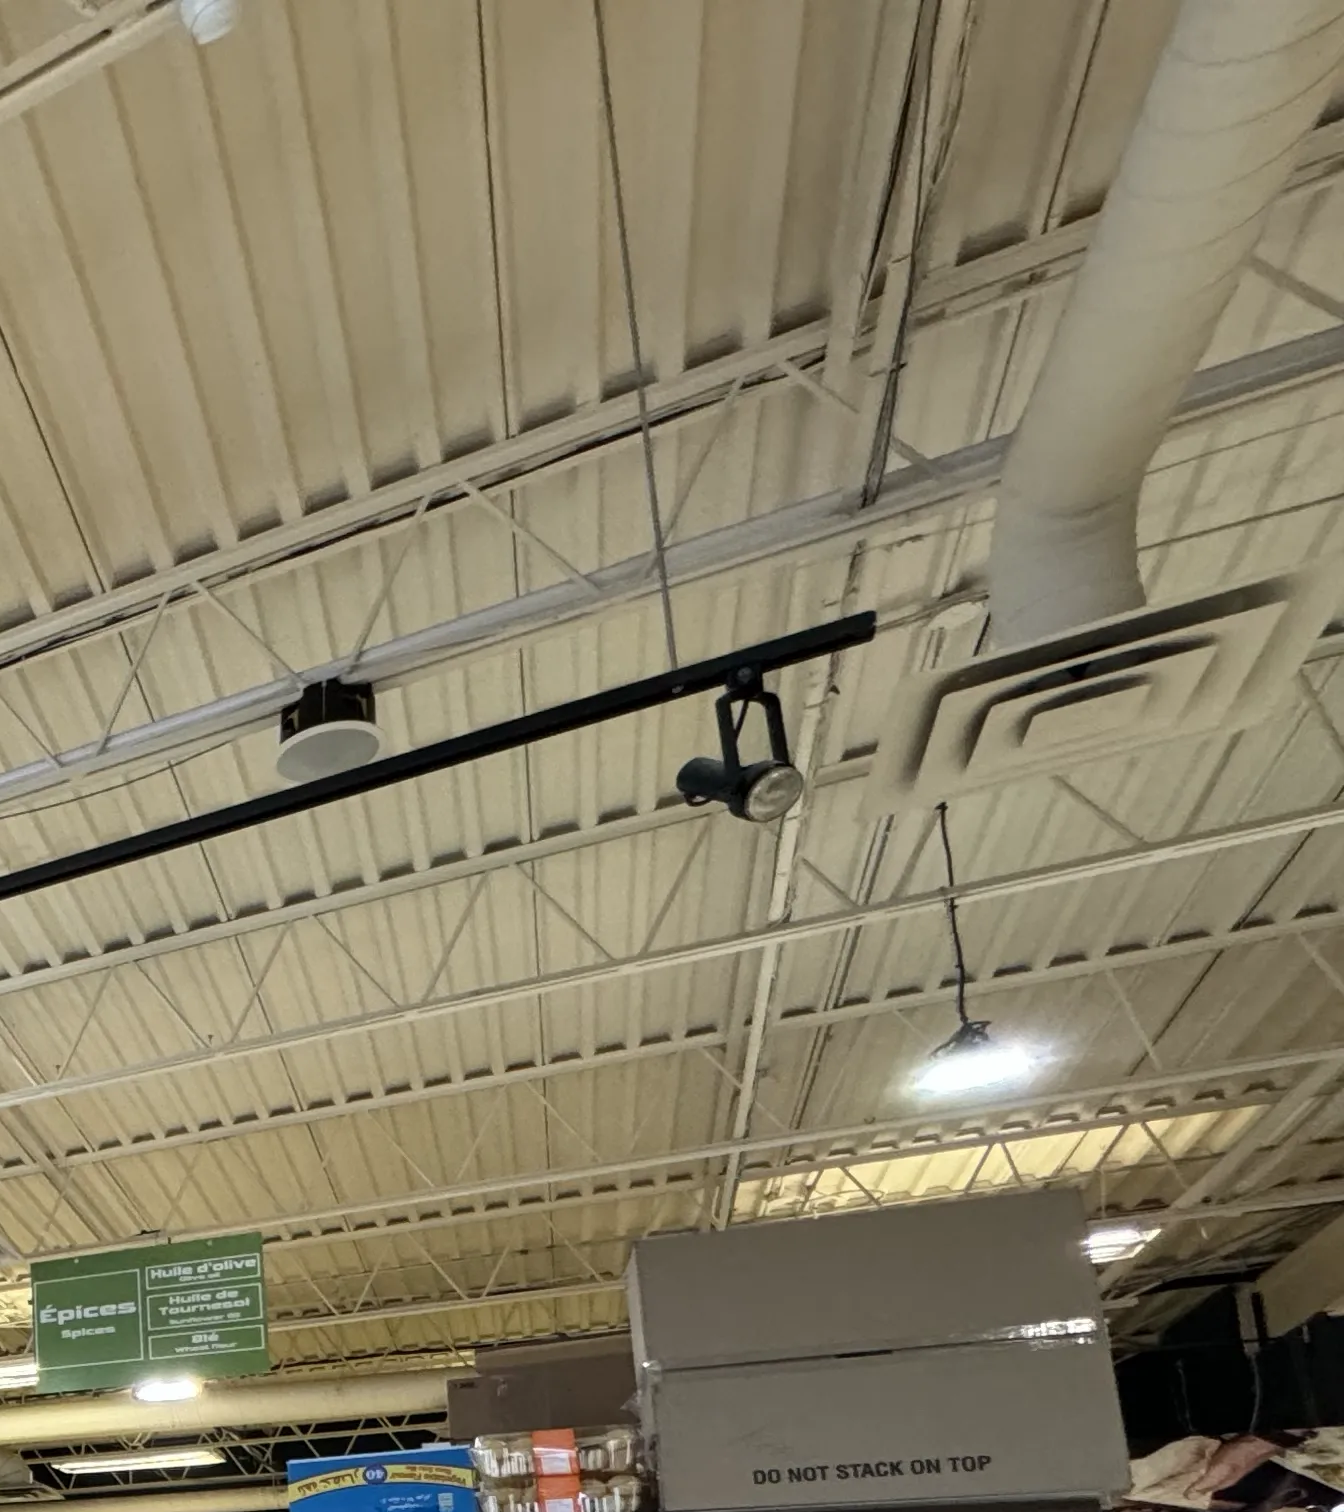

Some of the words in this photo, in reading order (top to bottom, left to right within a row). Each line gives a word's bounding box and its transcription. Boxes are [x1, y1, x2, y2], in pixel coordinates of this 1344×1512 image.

[150, 1267, 194, 1280] Huile
[197, 1258, 257, 1274] d'olive
[158, 1296, 251, 1316] Tournesol
[169, 1294, 212, 1305] Huile
[220, 1289, 239, 1299] de
[39, 1302, 137, 1326] Épices
[61, 1326, 116, 1340] Spices
[191, 1332, 219, 1344] Blé
[366, 1470, 385, 1480] 40
[752, 1469, 781, 1485] DO
[787, 1465, 830, 1483] NOT
[836, 1460, 905, 1480] STACK
[910, 1458, 942, 1475] ON
[947, 1455, 993, 1473] TOP
